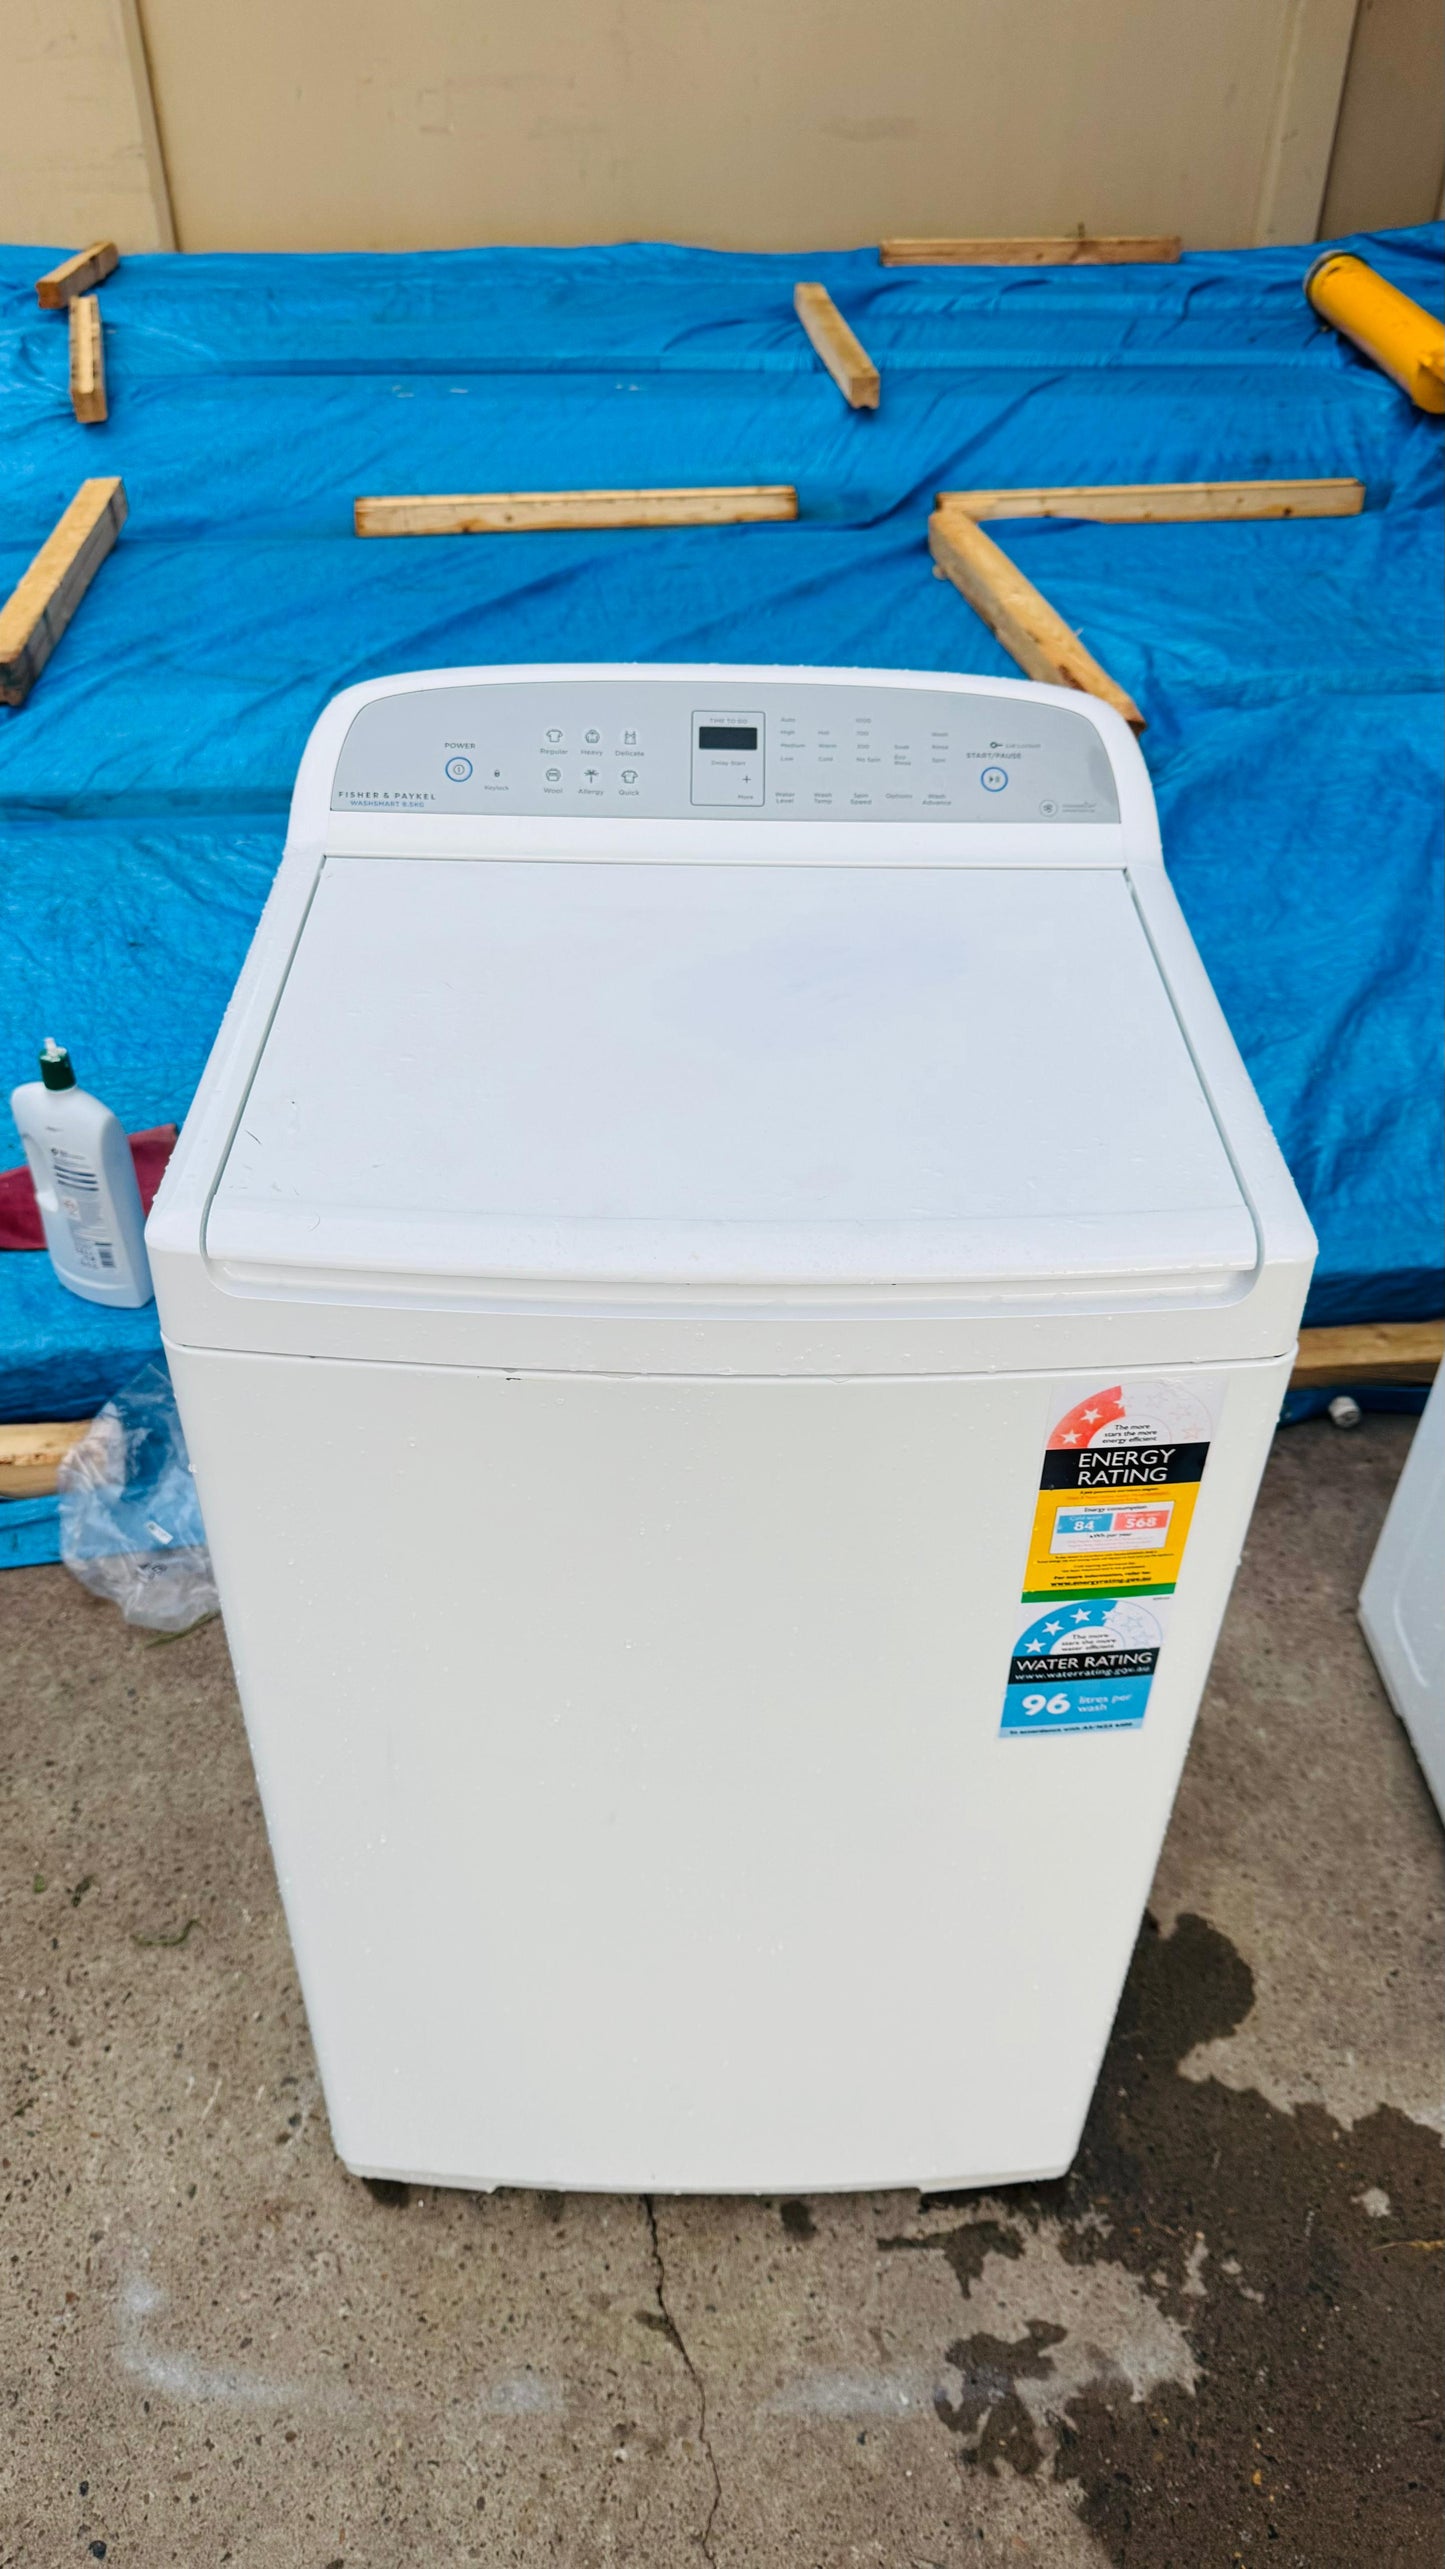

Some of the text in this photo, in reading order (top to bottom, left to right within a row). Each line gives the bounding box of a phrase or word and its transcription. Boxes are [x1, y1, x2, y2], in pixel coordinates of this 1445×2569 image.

[444, 742, 476, 750] POWER
[539, 748, 568, 756] Regular
[580, 749, 604, 757] Heavy
[615, 749, 645, 757] Delicate
[966, 751, 1022, 760] START/PAUSE
[338, 791, 380, 799] FISHER
[394, 792, 437, 801] PAYKEL
[578, 788, 604, 797] Allergy
[618, 789, 640, 797] Quick
[350, 800, 400, 808] WASHSMART
[1102, 1437, 1127, 1445] energy
[1078, 1448, 1176, 1468] ENERGY
[1077, 1467, 1169, 1486] RATING
[1073, 1520, 1096, 1532] 84
[1125, 1517, 1157, 1529] 568
[1016, 1652, 1153, 1672] WATER RATING
[1014, 1665, 1151, 1681] www.waterrating.gov.au
[1078, 1693, 1134, 1705] litres per
[1021, 1692, 1071, 1717] 96
[1077, 1704, 1108, 1713] wash
